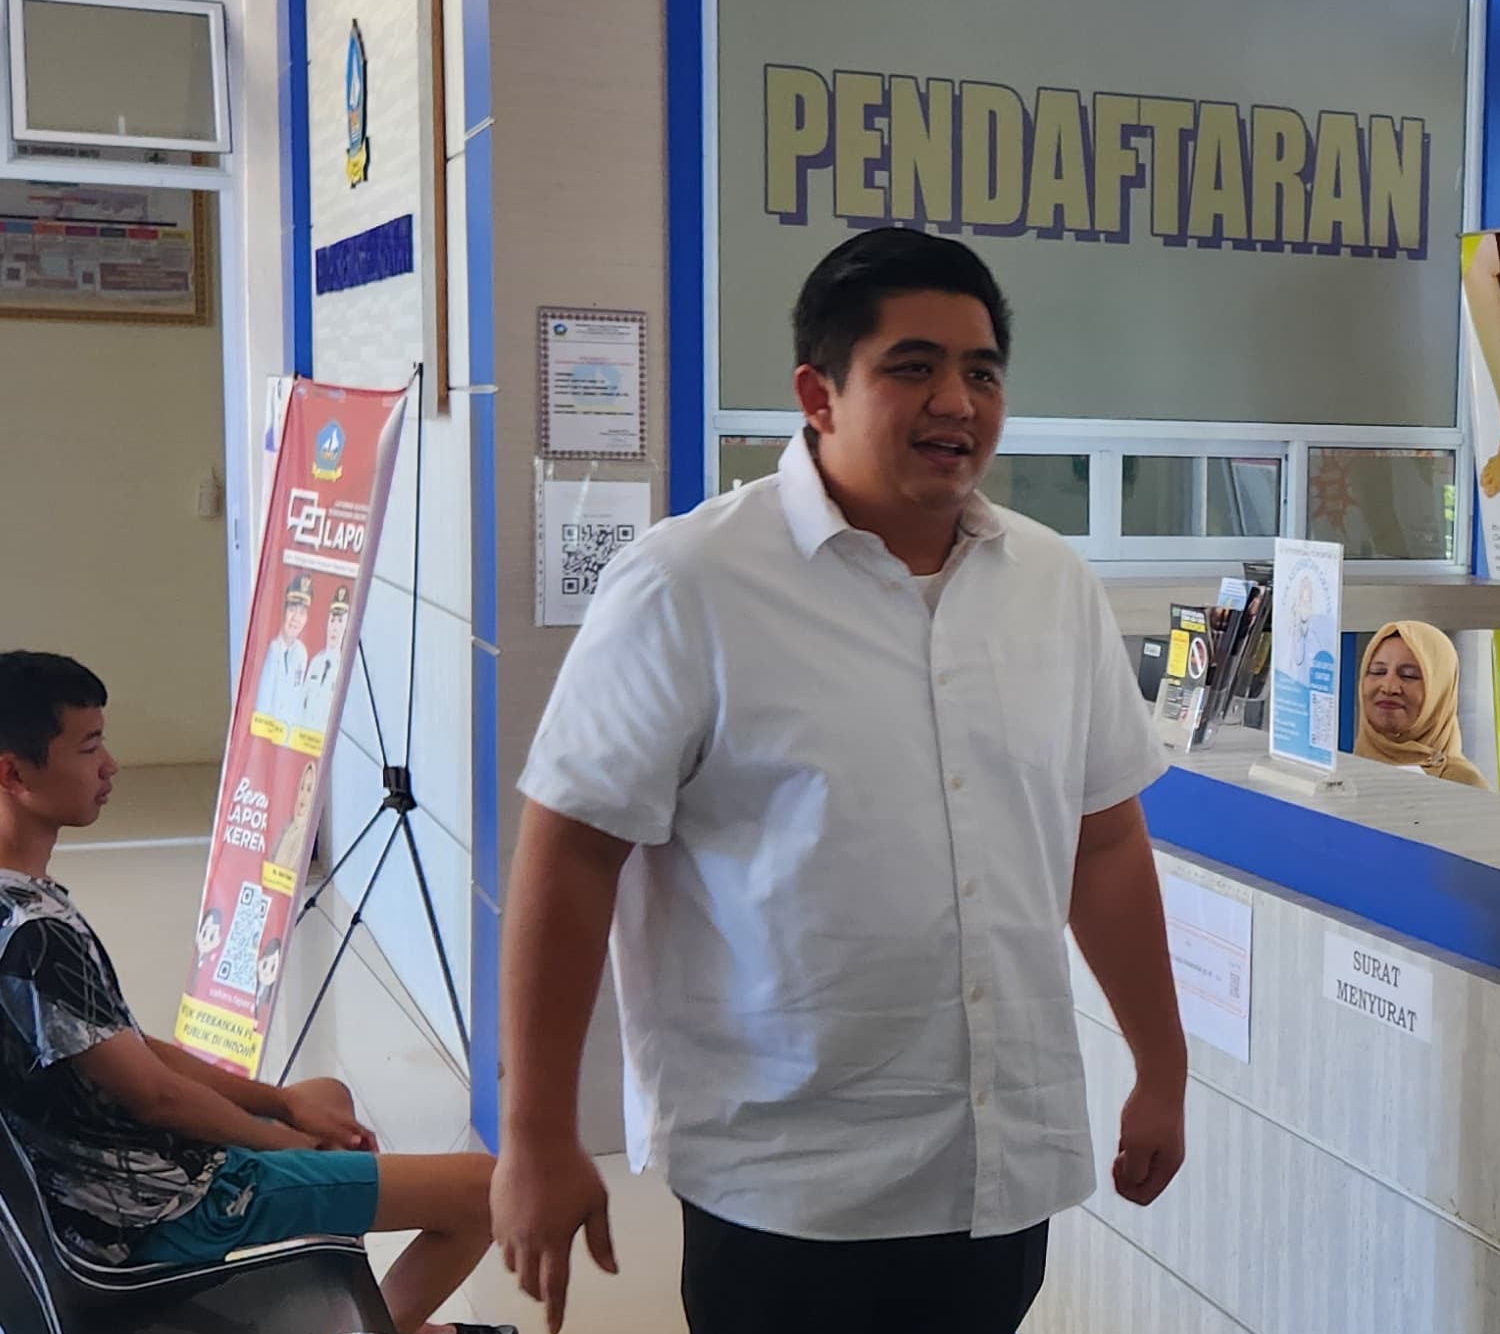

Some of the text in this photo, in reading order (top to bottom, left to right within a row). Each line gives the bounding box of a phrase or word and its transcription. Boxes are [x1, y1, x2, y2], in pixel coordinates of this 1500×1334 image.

[764, 63, 1431, 261] PENDAFTARAN
[1353, 950, 1400, 988] SURAT
[1335, 979, 1418, 1032] MENYURAT
